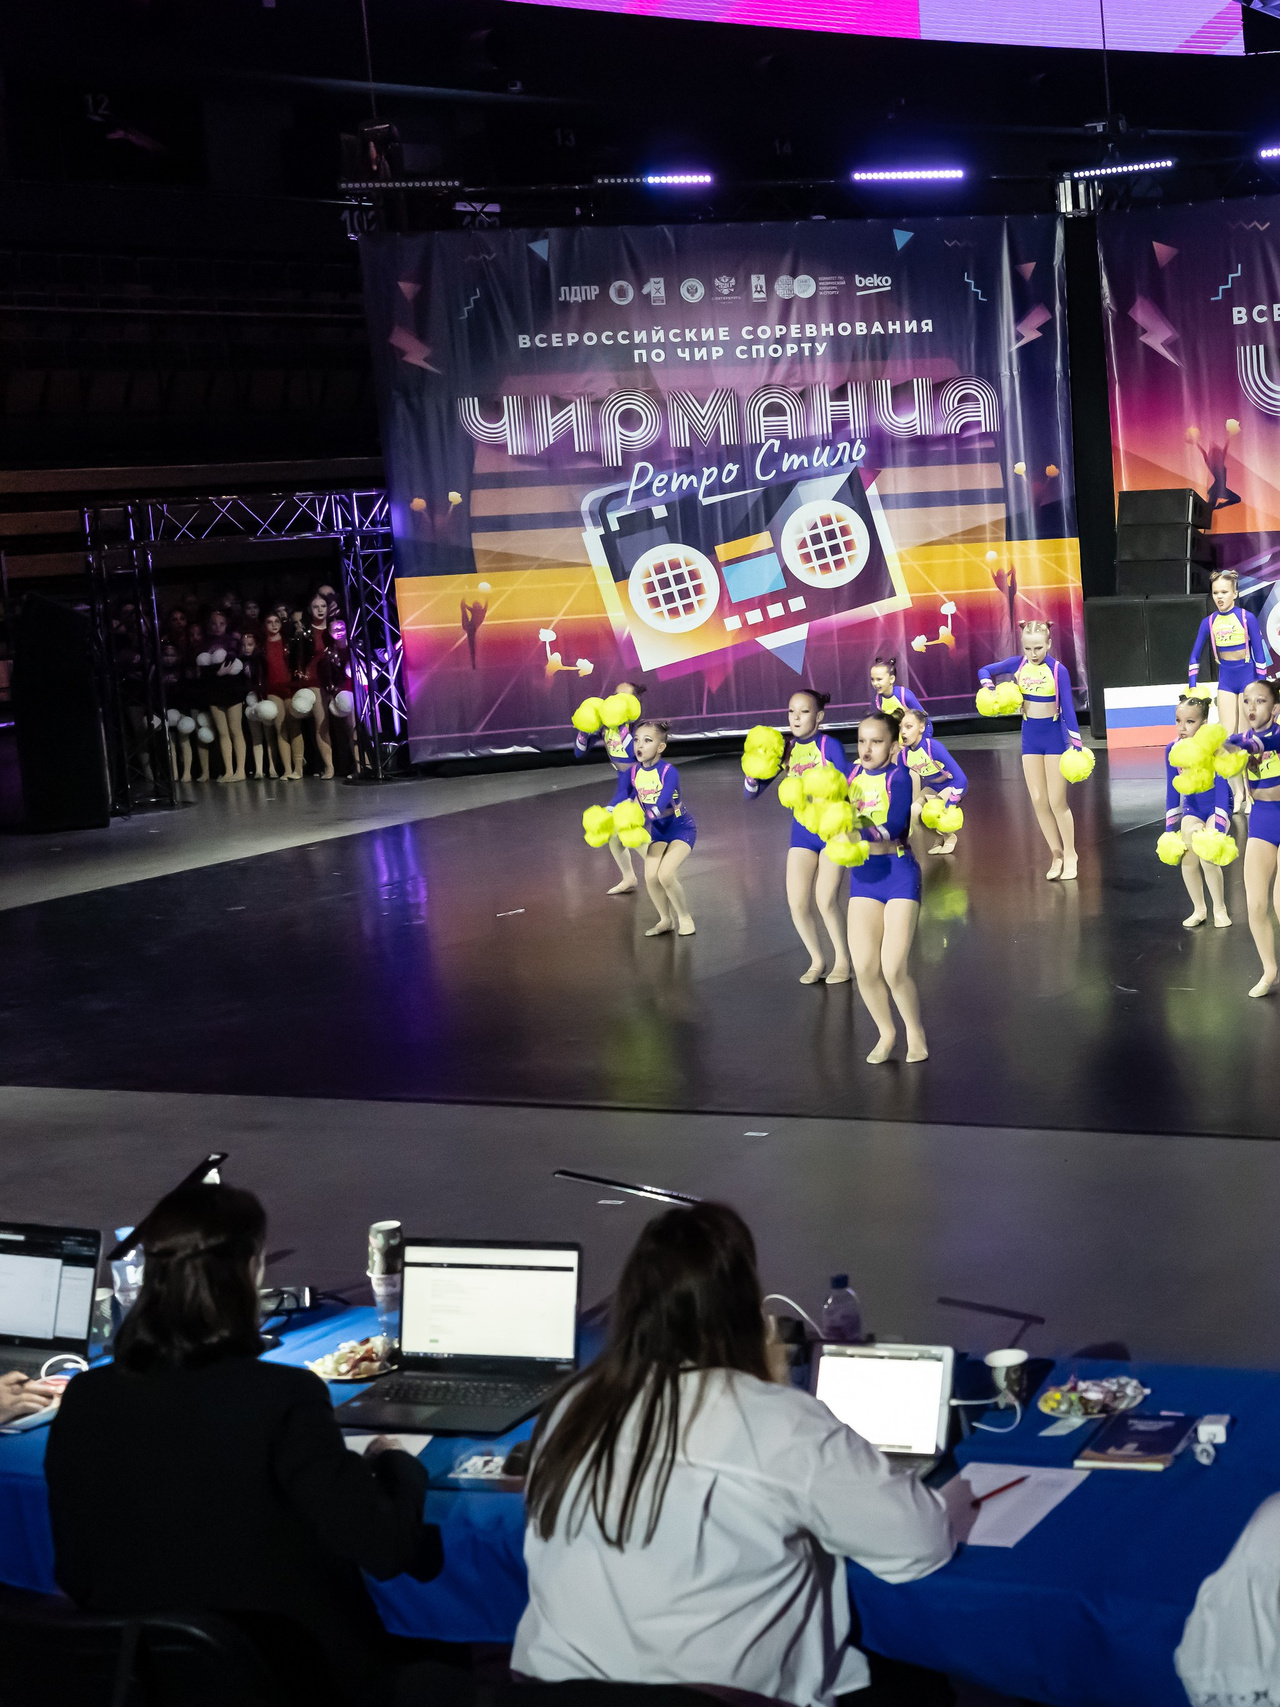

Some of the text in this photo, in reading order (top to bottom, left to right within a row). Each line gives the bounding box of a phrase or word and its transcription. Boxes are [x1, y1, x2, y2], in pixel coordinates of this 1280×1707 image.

[84, 93, 110, 114] 12
[855, 273, 892, 287] beko
[558, 285, 600, 304] ЛДПР
[518, 319, 933, 348] ВСЕРОССИЙСКИЕ СОРЕВНОВАНИЯ
[634, 342, 828, 363] ПО ЧИР СПОРТУ
[626, 437, 867, 506] Ретро Стиль
